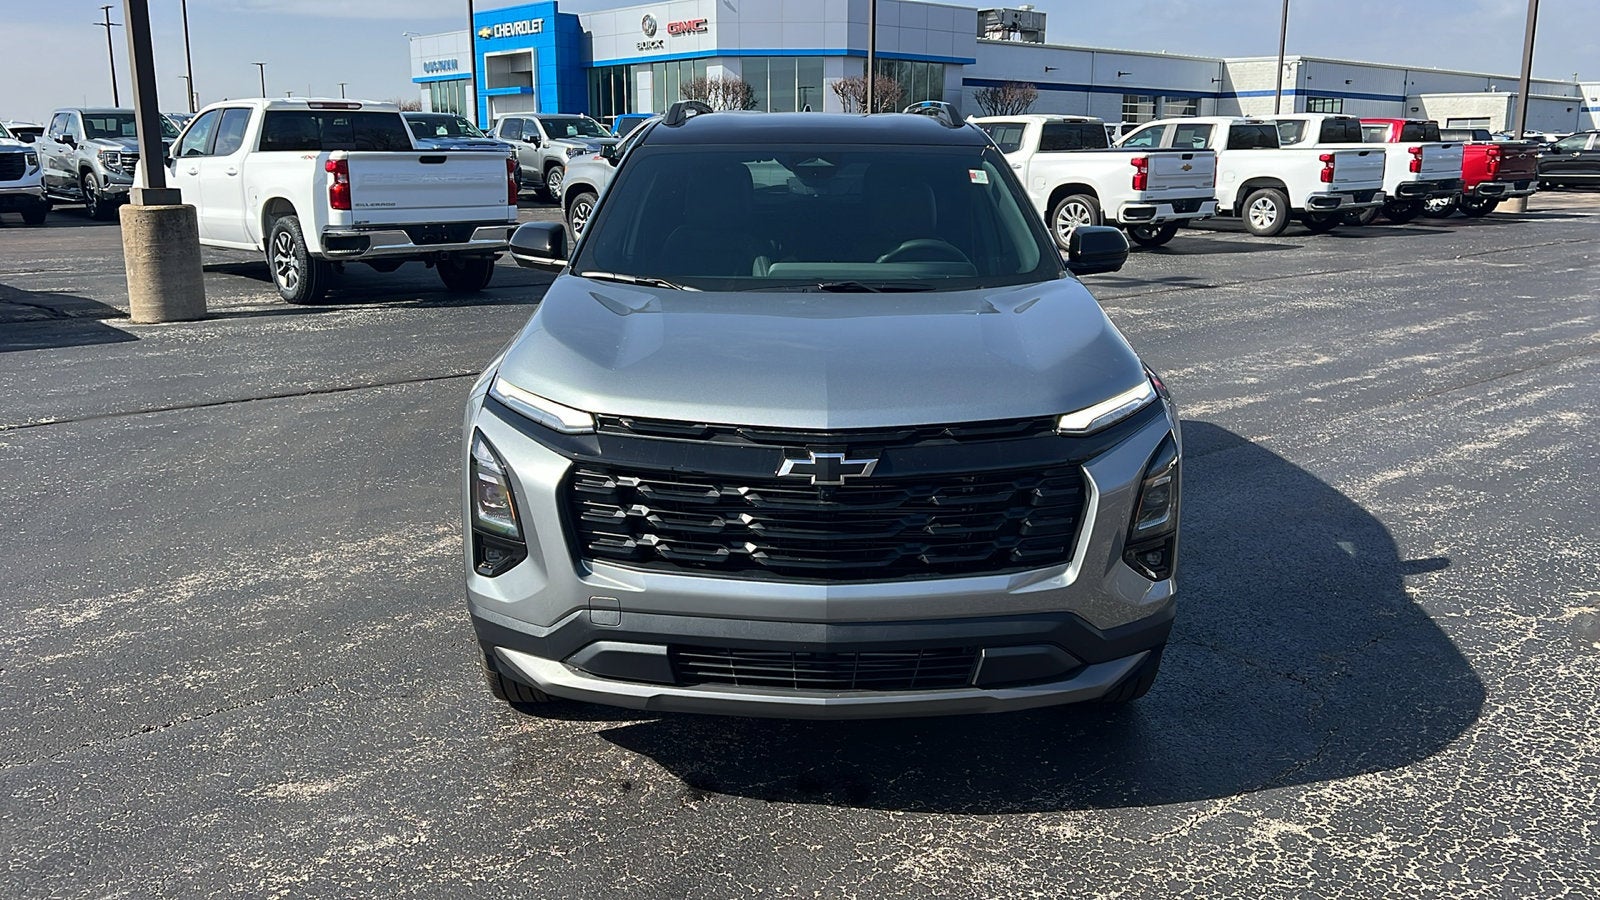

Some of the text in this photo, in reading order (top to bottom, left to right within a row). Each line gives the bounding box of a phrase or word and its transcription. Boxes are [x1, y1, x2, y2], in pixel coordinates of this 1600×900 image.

[493, 18, 545, 38] CHEVROLET
[667, 18, 707, 36] GMC
[636, 39, 664, 51] BUICK
